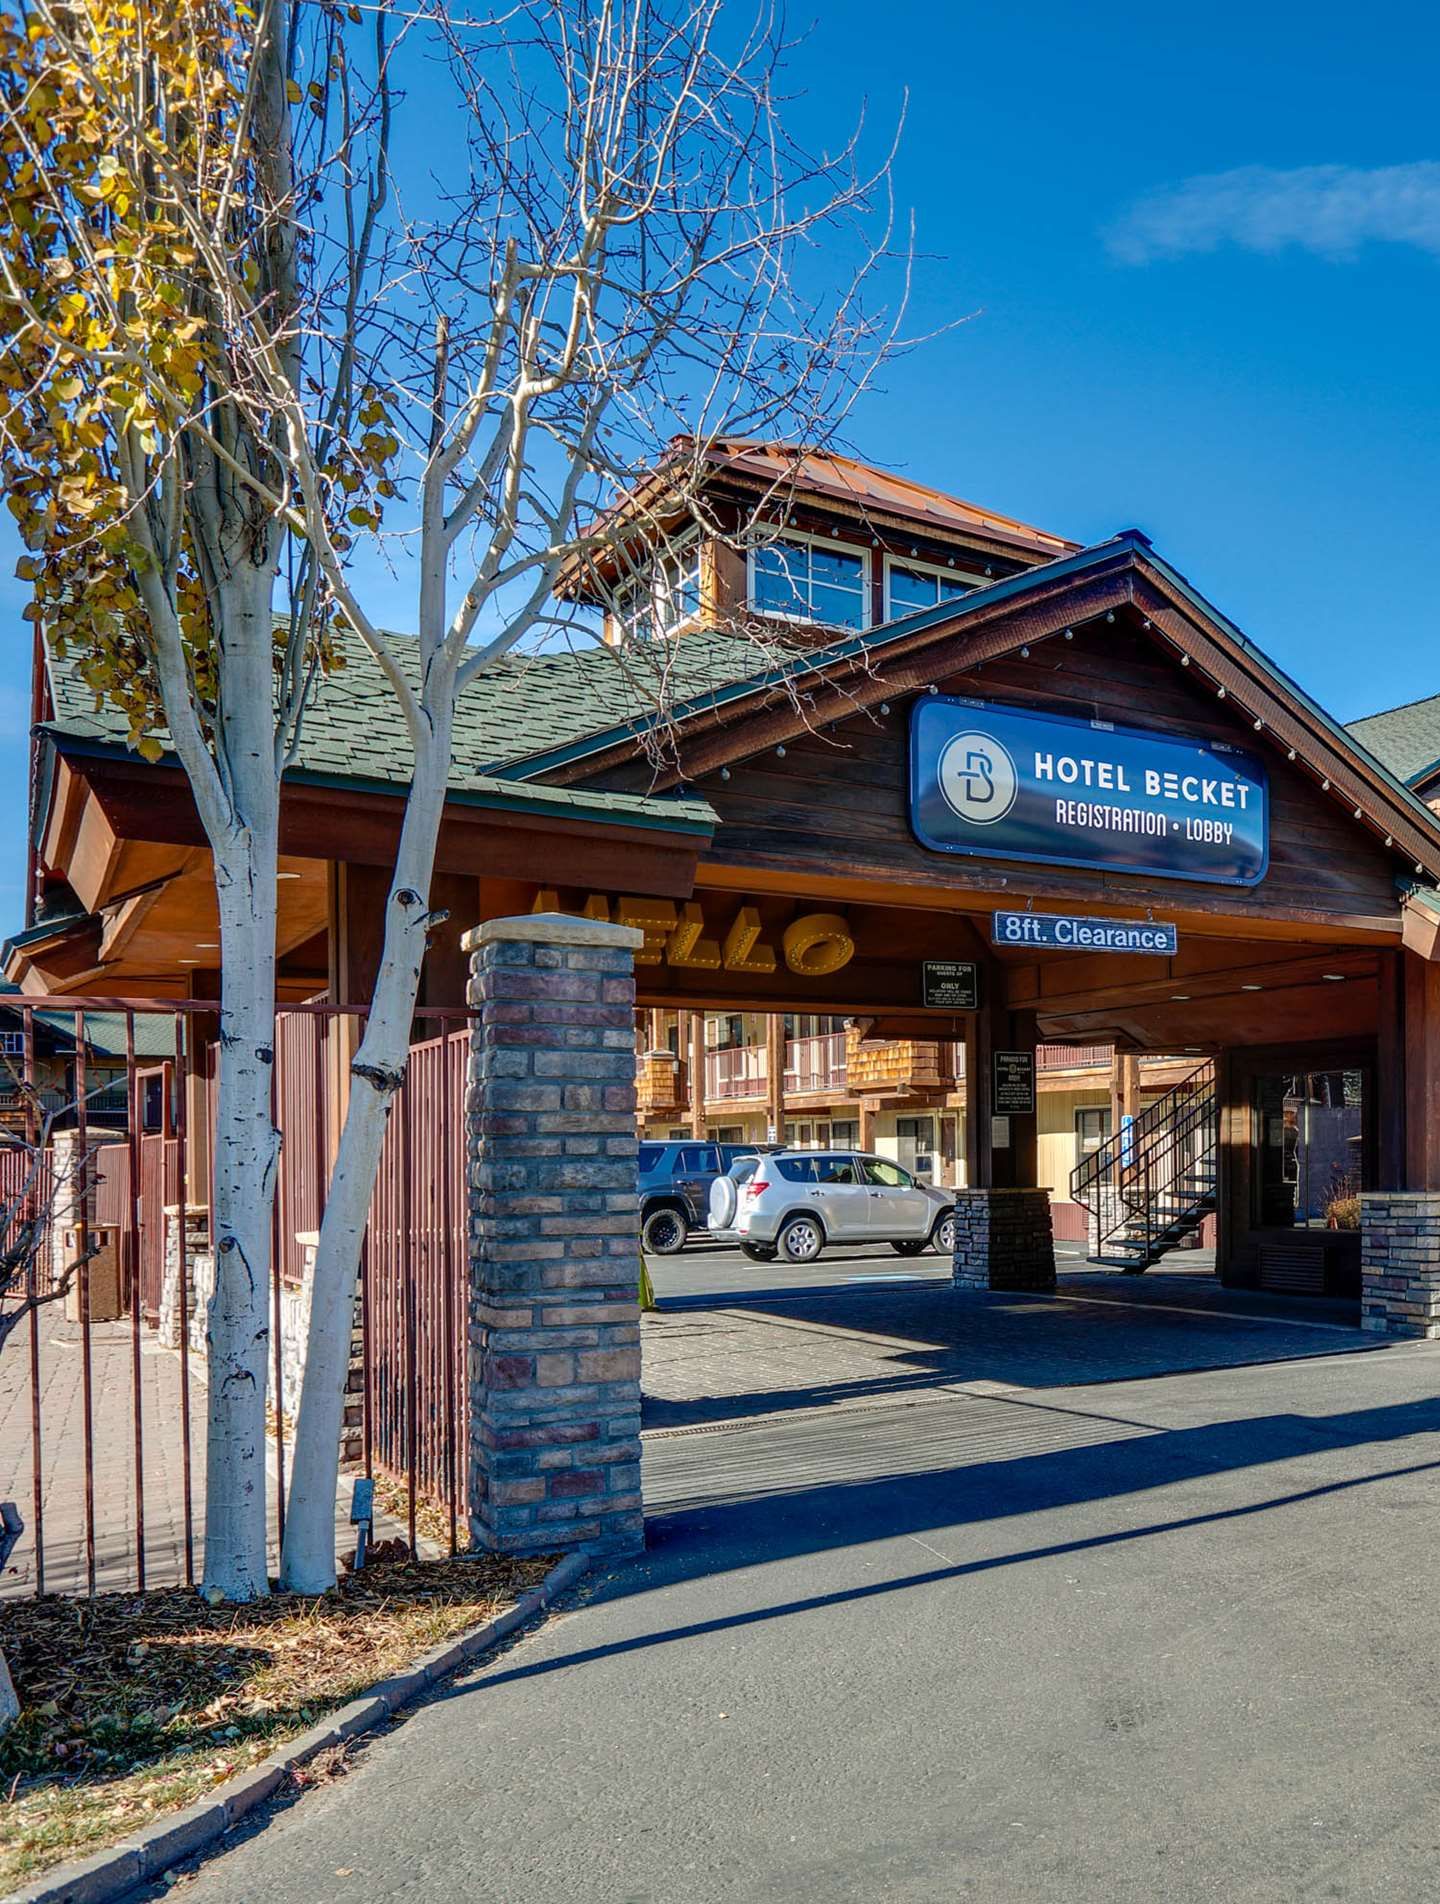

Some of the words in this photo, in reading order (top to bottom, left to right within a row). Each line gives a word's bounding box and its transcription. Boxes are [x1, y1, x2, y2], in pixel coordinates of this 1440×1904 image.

[1035, 752, 1131, 792] HOTEL
[1145, 769, 1249, 809] BECKET
[1056, 799, 1167, 837] REGISTRATION
[1186, 817, 1233, 845] LOBBY
[1005, 916, 1047, 942] 8ft.
[1054, 919, 1168, 949] Clearance
[927, 964, 957, 972] PARKING
[940, 982, 960, 990] ONLY
